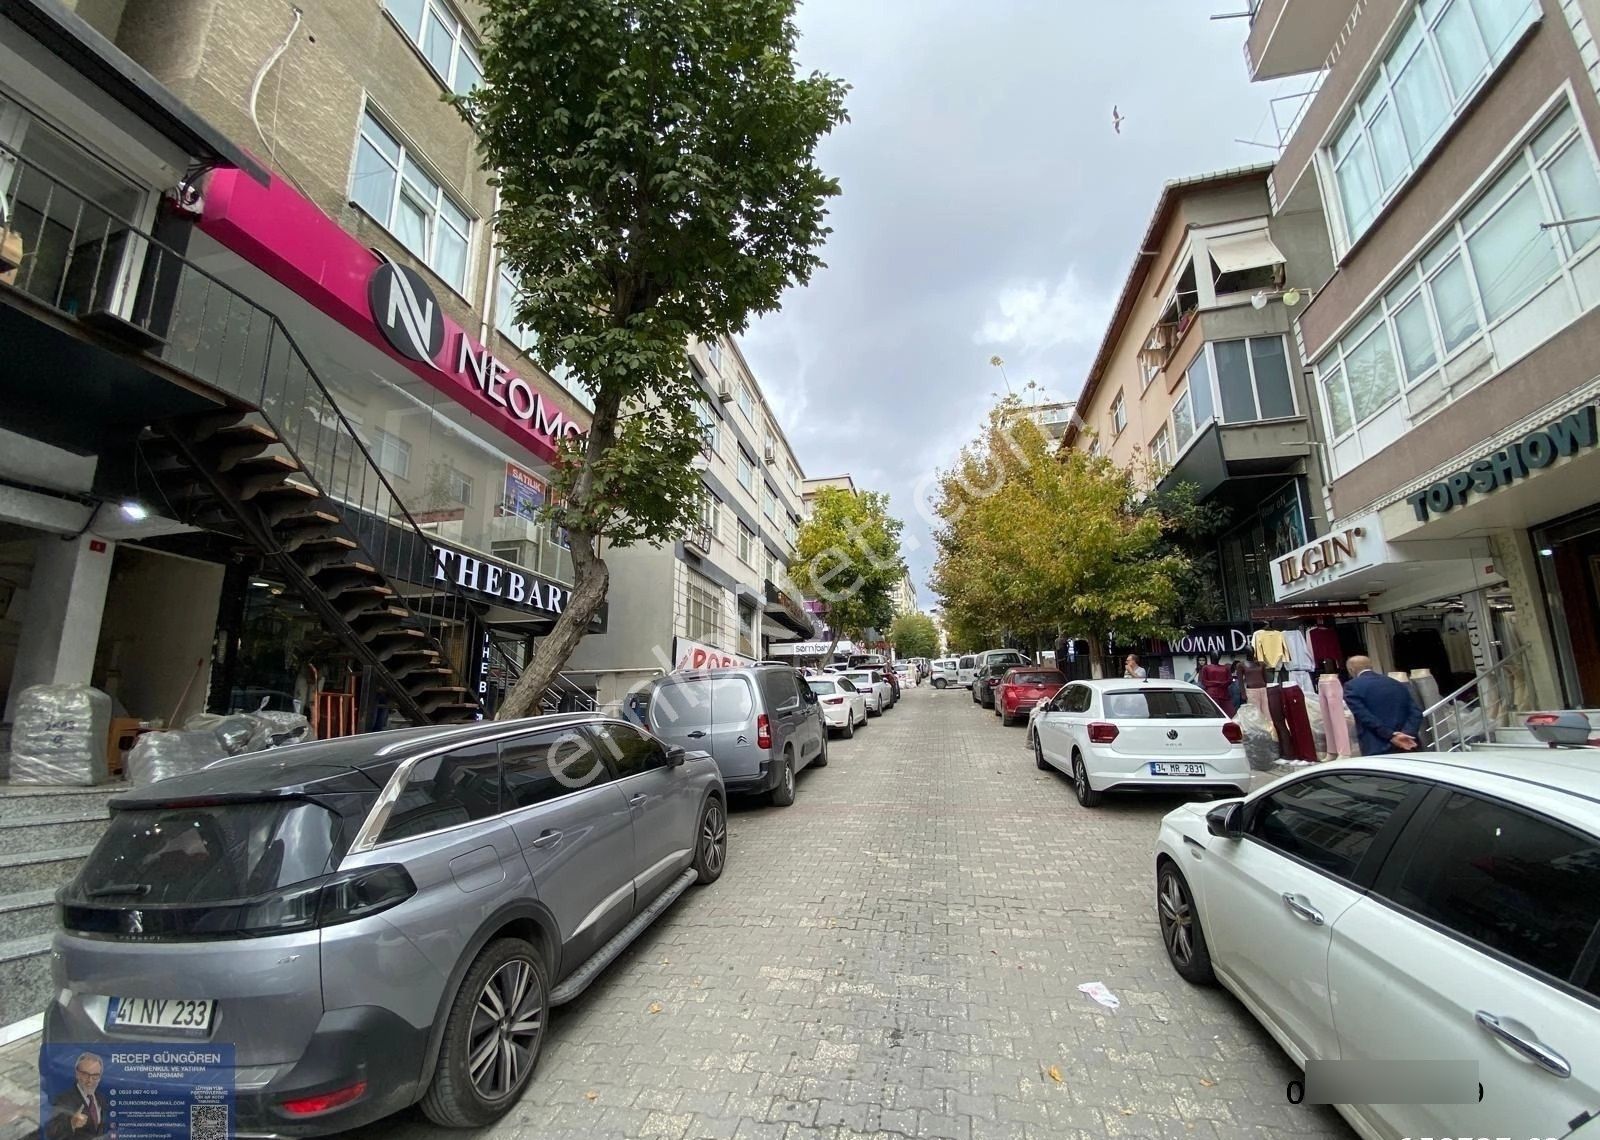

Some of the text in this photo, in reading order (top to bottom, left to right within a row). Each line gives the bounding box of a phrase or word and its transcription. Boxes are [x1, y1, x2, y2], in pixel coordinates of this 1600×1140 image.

[1407, 405, 1597, 521] TOPSHOW
[1279, 528, 1356, 585] ILGIN
[431, 545, 573, 613] THEBAR
[1309, 574, 1334, 588] LIFE
[1168, 635, 1226, 653] WOMAN
[1156, 763, 1166, 772] 34
[1185, 764, 1203, 773] 2831
[117, 997, 207, 1027] 41 NY 233
